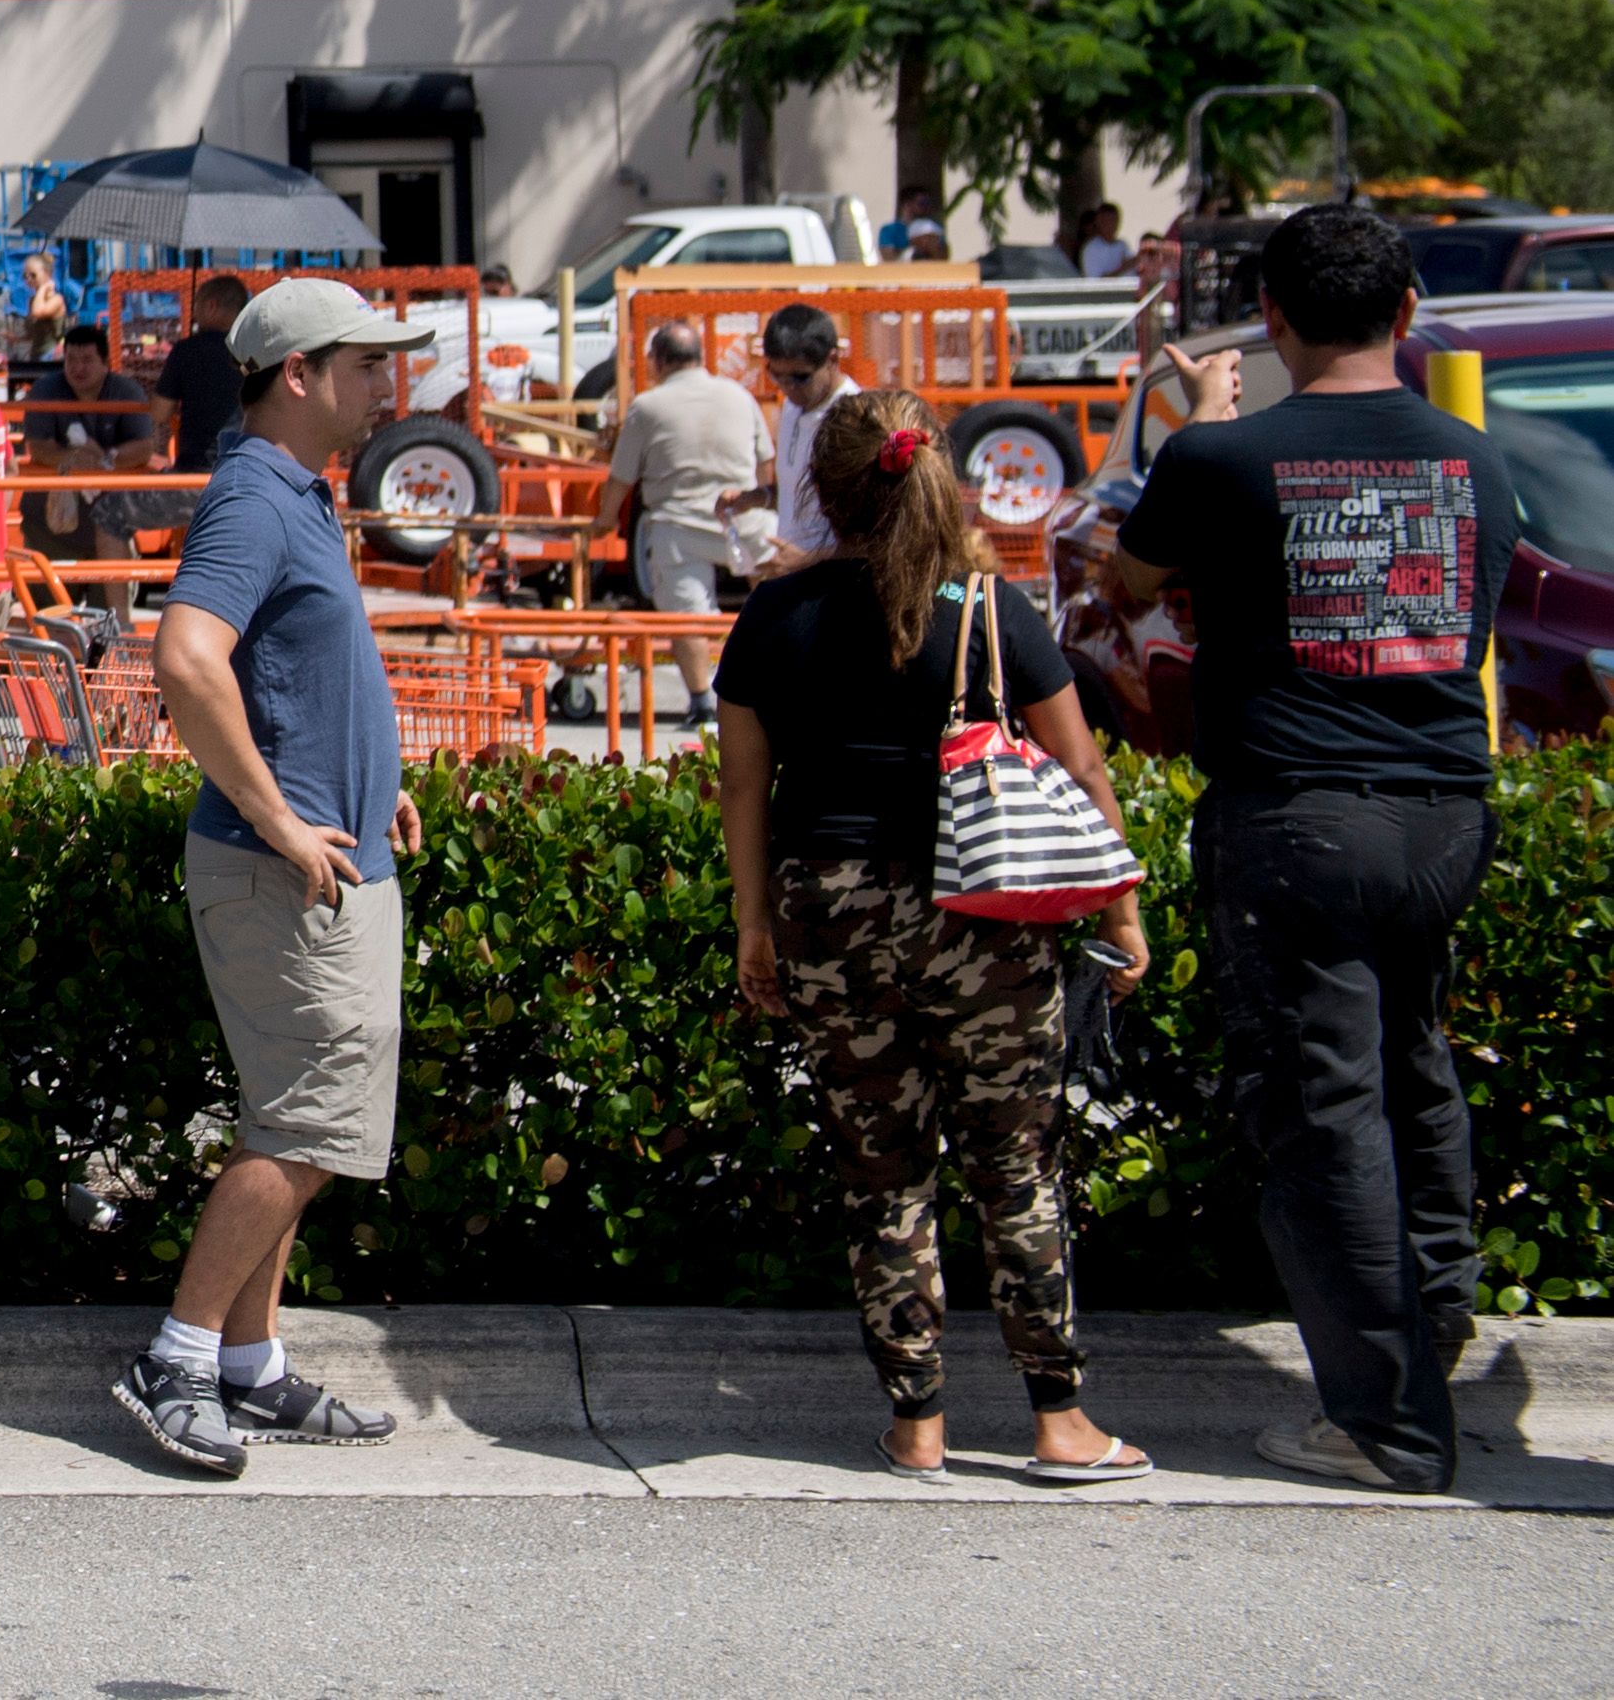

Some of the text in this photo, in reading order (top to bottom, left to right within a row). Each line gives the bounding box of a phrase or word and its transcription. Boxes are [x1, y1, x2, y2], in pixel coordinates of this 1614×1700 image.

[1273, 460, 1415, 478] BROOKLYN
[1441, 460, 1469, 476] FAST
[1341, 488, 1381, 517] oil
[1284, 511, 1394, 543] filters
[1283, 540, 1393, 561] PERFORMANCE
[1456, 517, 1477, 612] QUEENS
[1300, 569, 1389, 588] brakes
[1387, 567, 1443, 595] ARCH
[1287, 594, 1365, 617] DURABLE
[1383, 594, 1444, 611] EXPERTISE
[1290, 627, 1343, 642] LONG
[1347, 625, 1409, 641] ISLAND
[1289, 638, 1374, 677] TRUST
